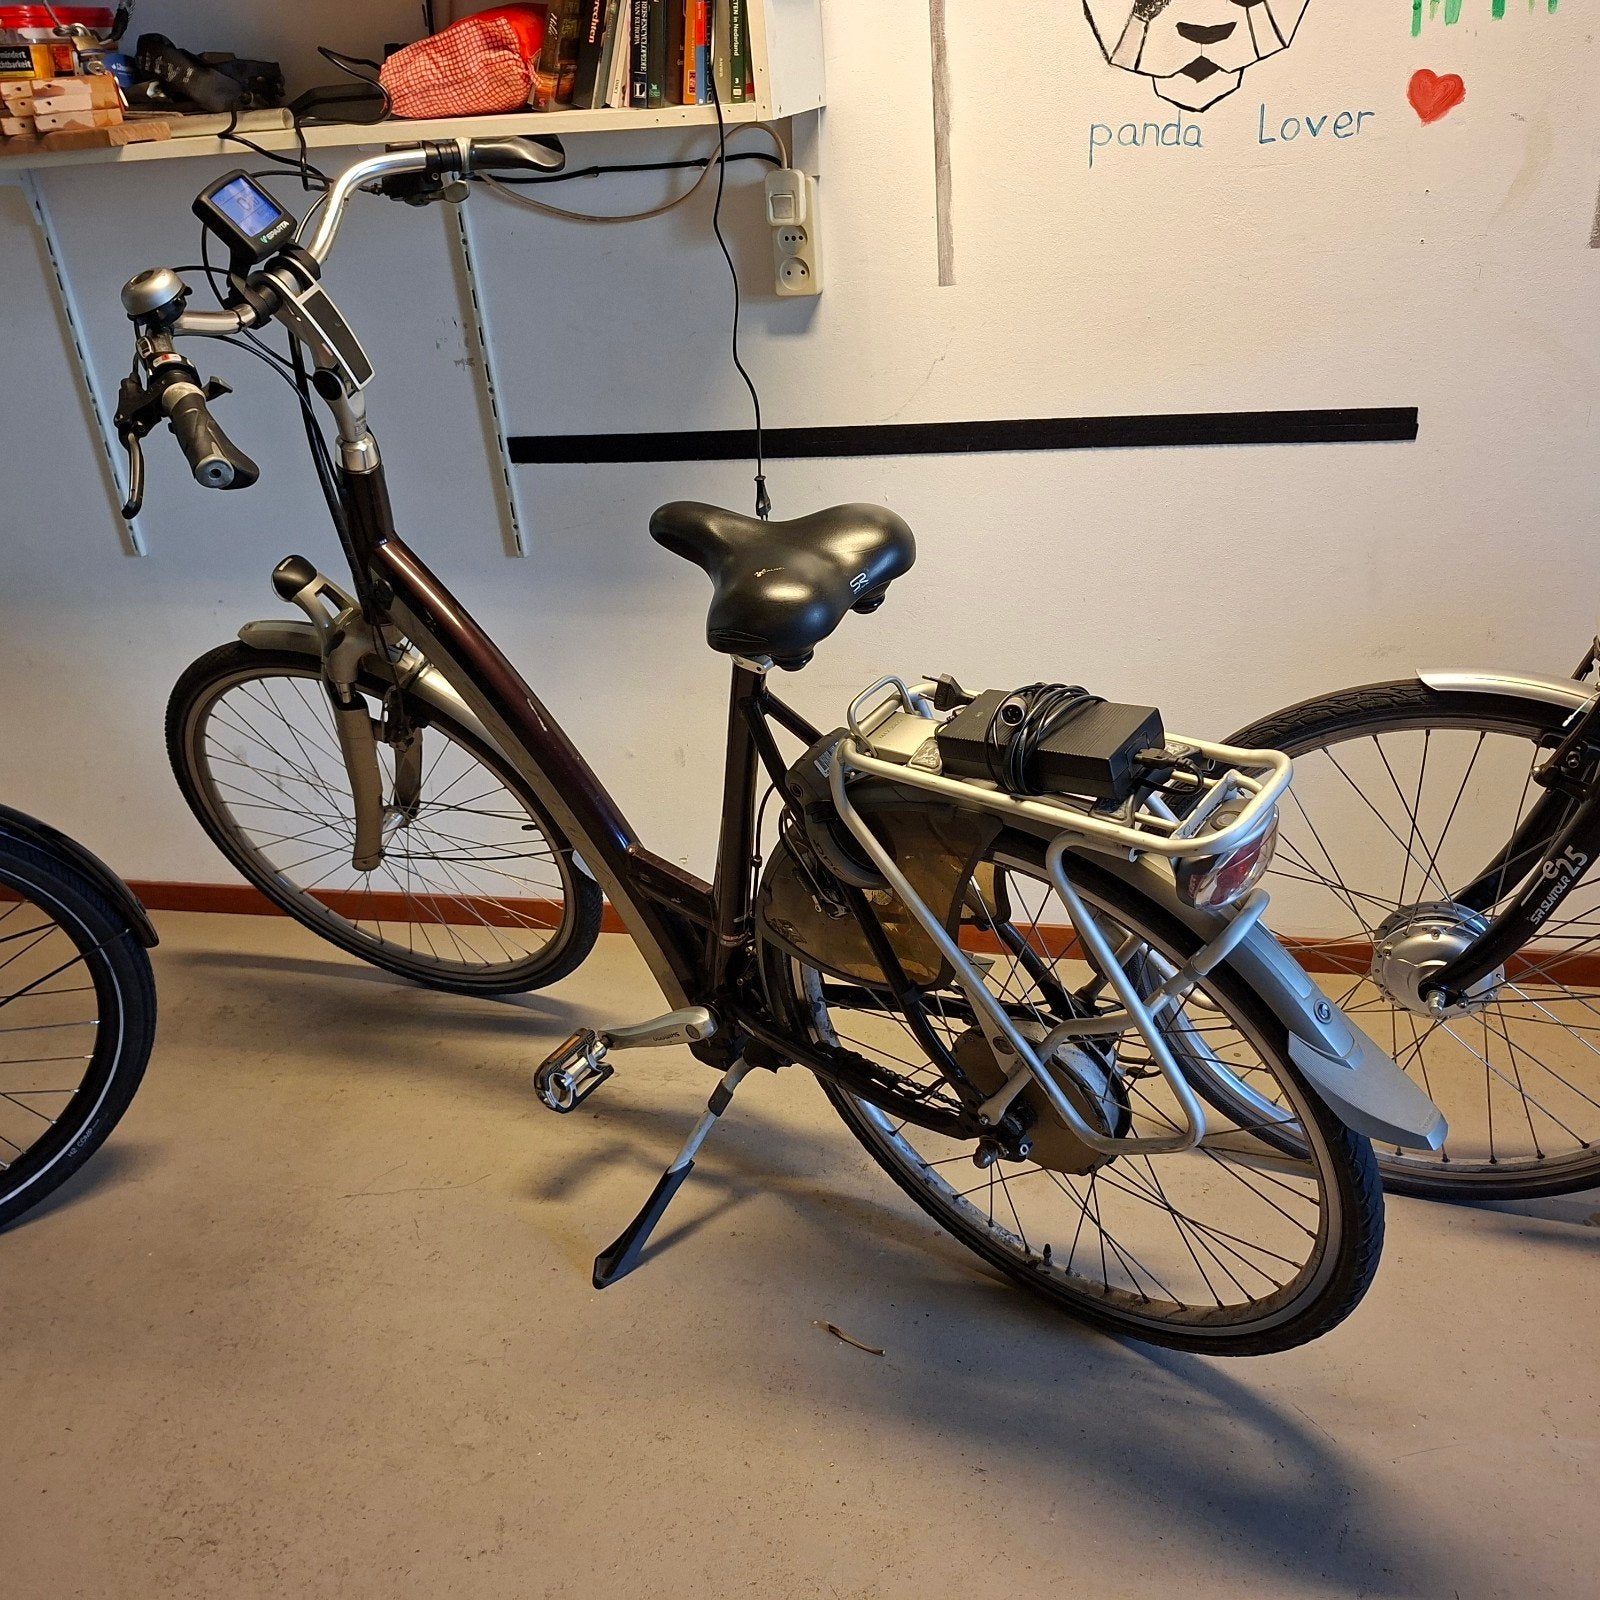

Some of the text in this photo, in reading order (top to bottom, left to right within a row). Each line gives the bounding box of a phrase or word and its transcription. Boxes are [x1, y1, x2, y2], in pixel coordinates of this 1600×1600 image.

[1088, 103, 1376, 169] panda Lover
[1540, 875, 1571, 912] SUNTOUR
